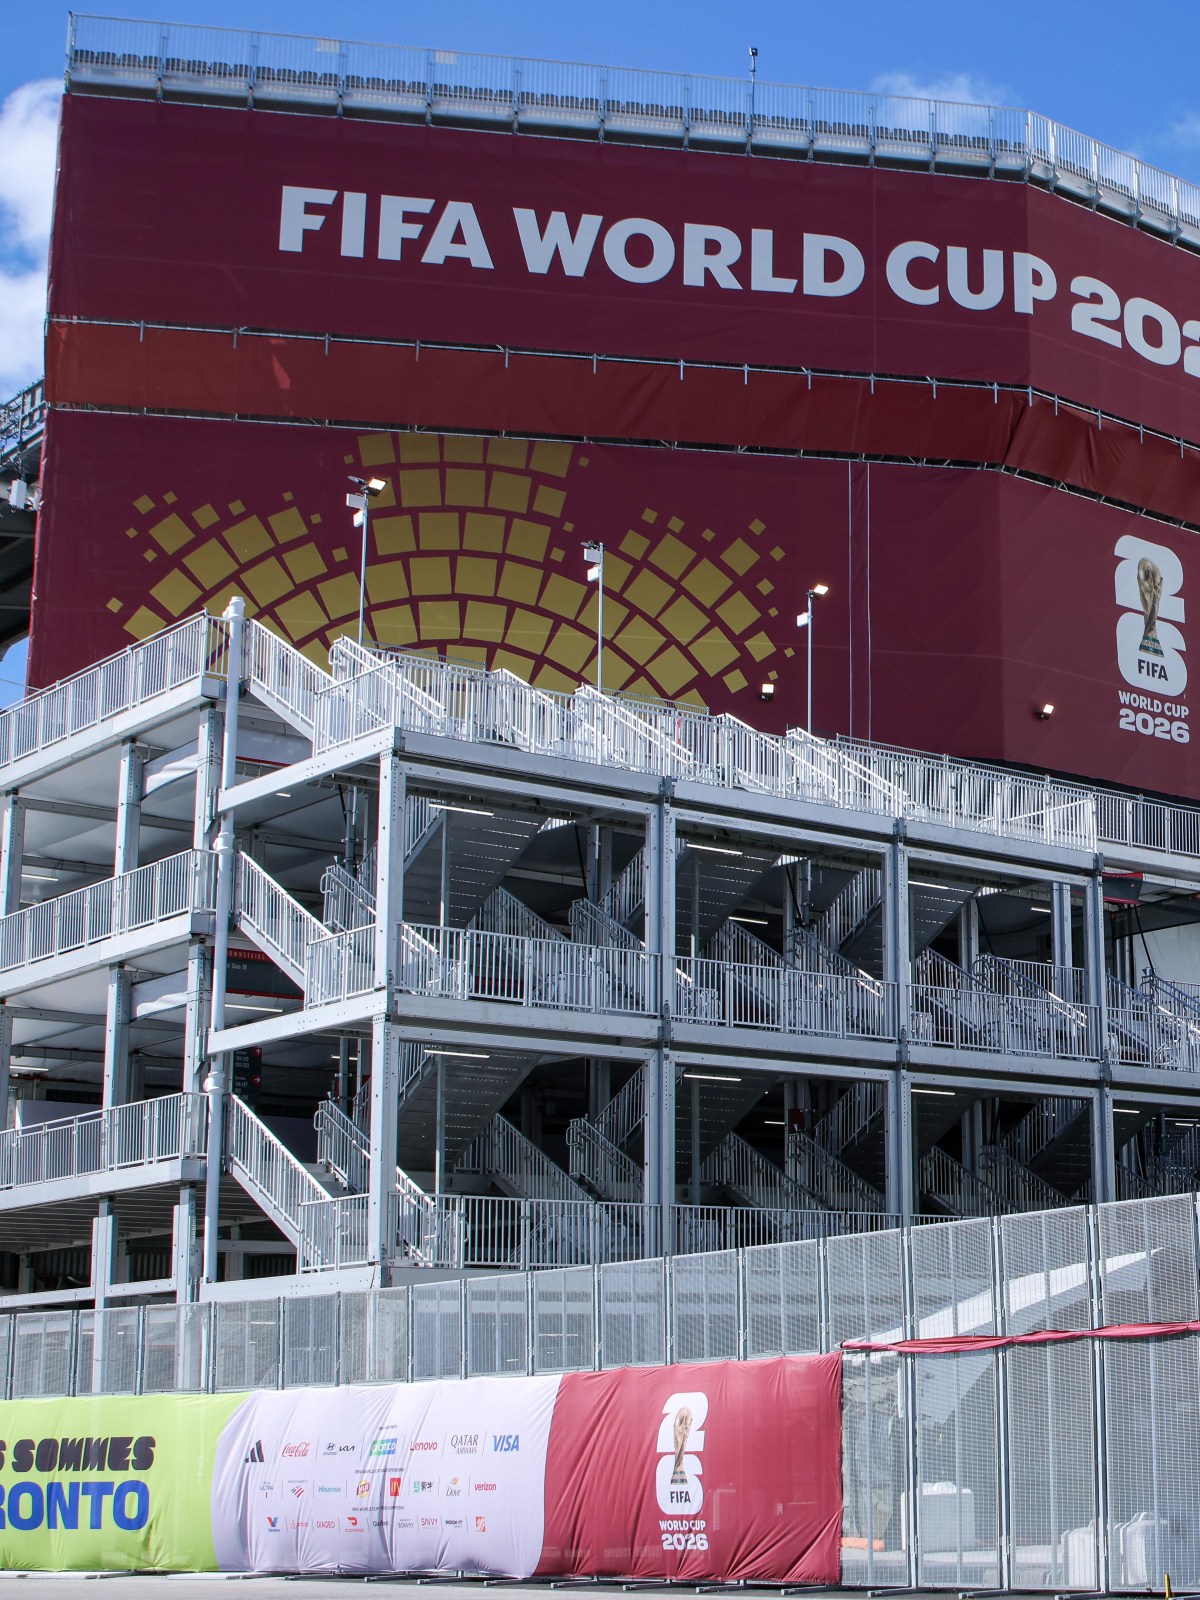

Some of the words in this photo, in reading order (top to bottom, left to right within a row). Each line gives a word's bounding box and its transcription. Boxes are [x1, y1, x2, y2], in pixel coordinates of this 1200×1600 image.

[279, 185, 495, 270] FIFA
[513, 207, 865, 298] WORLD
[886, 240, 1057, 315] CUP
[1137, 658, 1169, 682] FIFA
[1118, 689, 1163, 713] WORLD
[1163, 702, 1189, 719] CUP
[1119, 707, 1190, 744] 2026
[228, 950, 266, 960] OWNSTAIRS
[409, 1440, 438, 1451] Lenovo
[450, 1434, 479, 1448] QATAR
[492, 1434, 520, 1452] VISA
[11, 1435, 157, 1473] SOMMES
[445, 1486, 462, 1497] Dove
[474, 1482, 497, 1491] verizon
[670, 1490, 691, 1503] FIFA
[0, 1479, 150, 1531] ONTO
[316, 1520, 336, 1529] DIAGEO
[659, 1519, 689, 1531] WORLD
[689, 1519, 706, 1531] CUP
[661, 1532, 709, 1551] 2026
